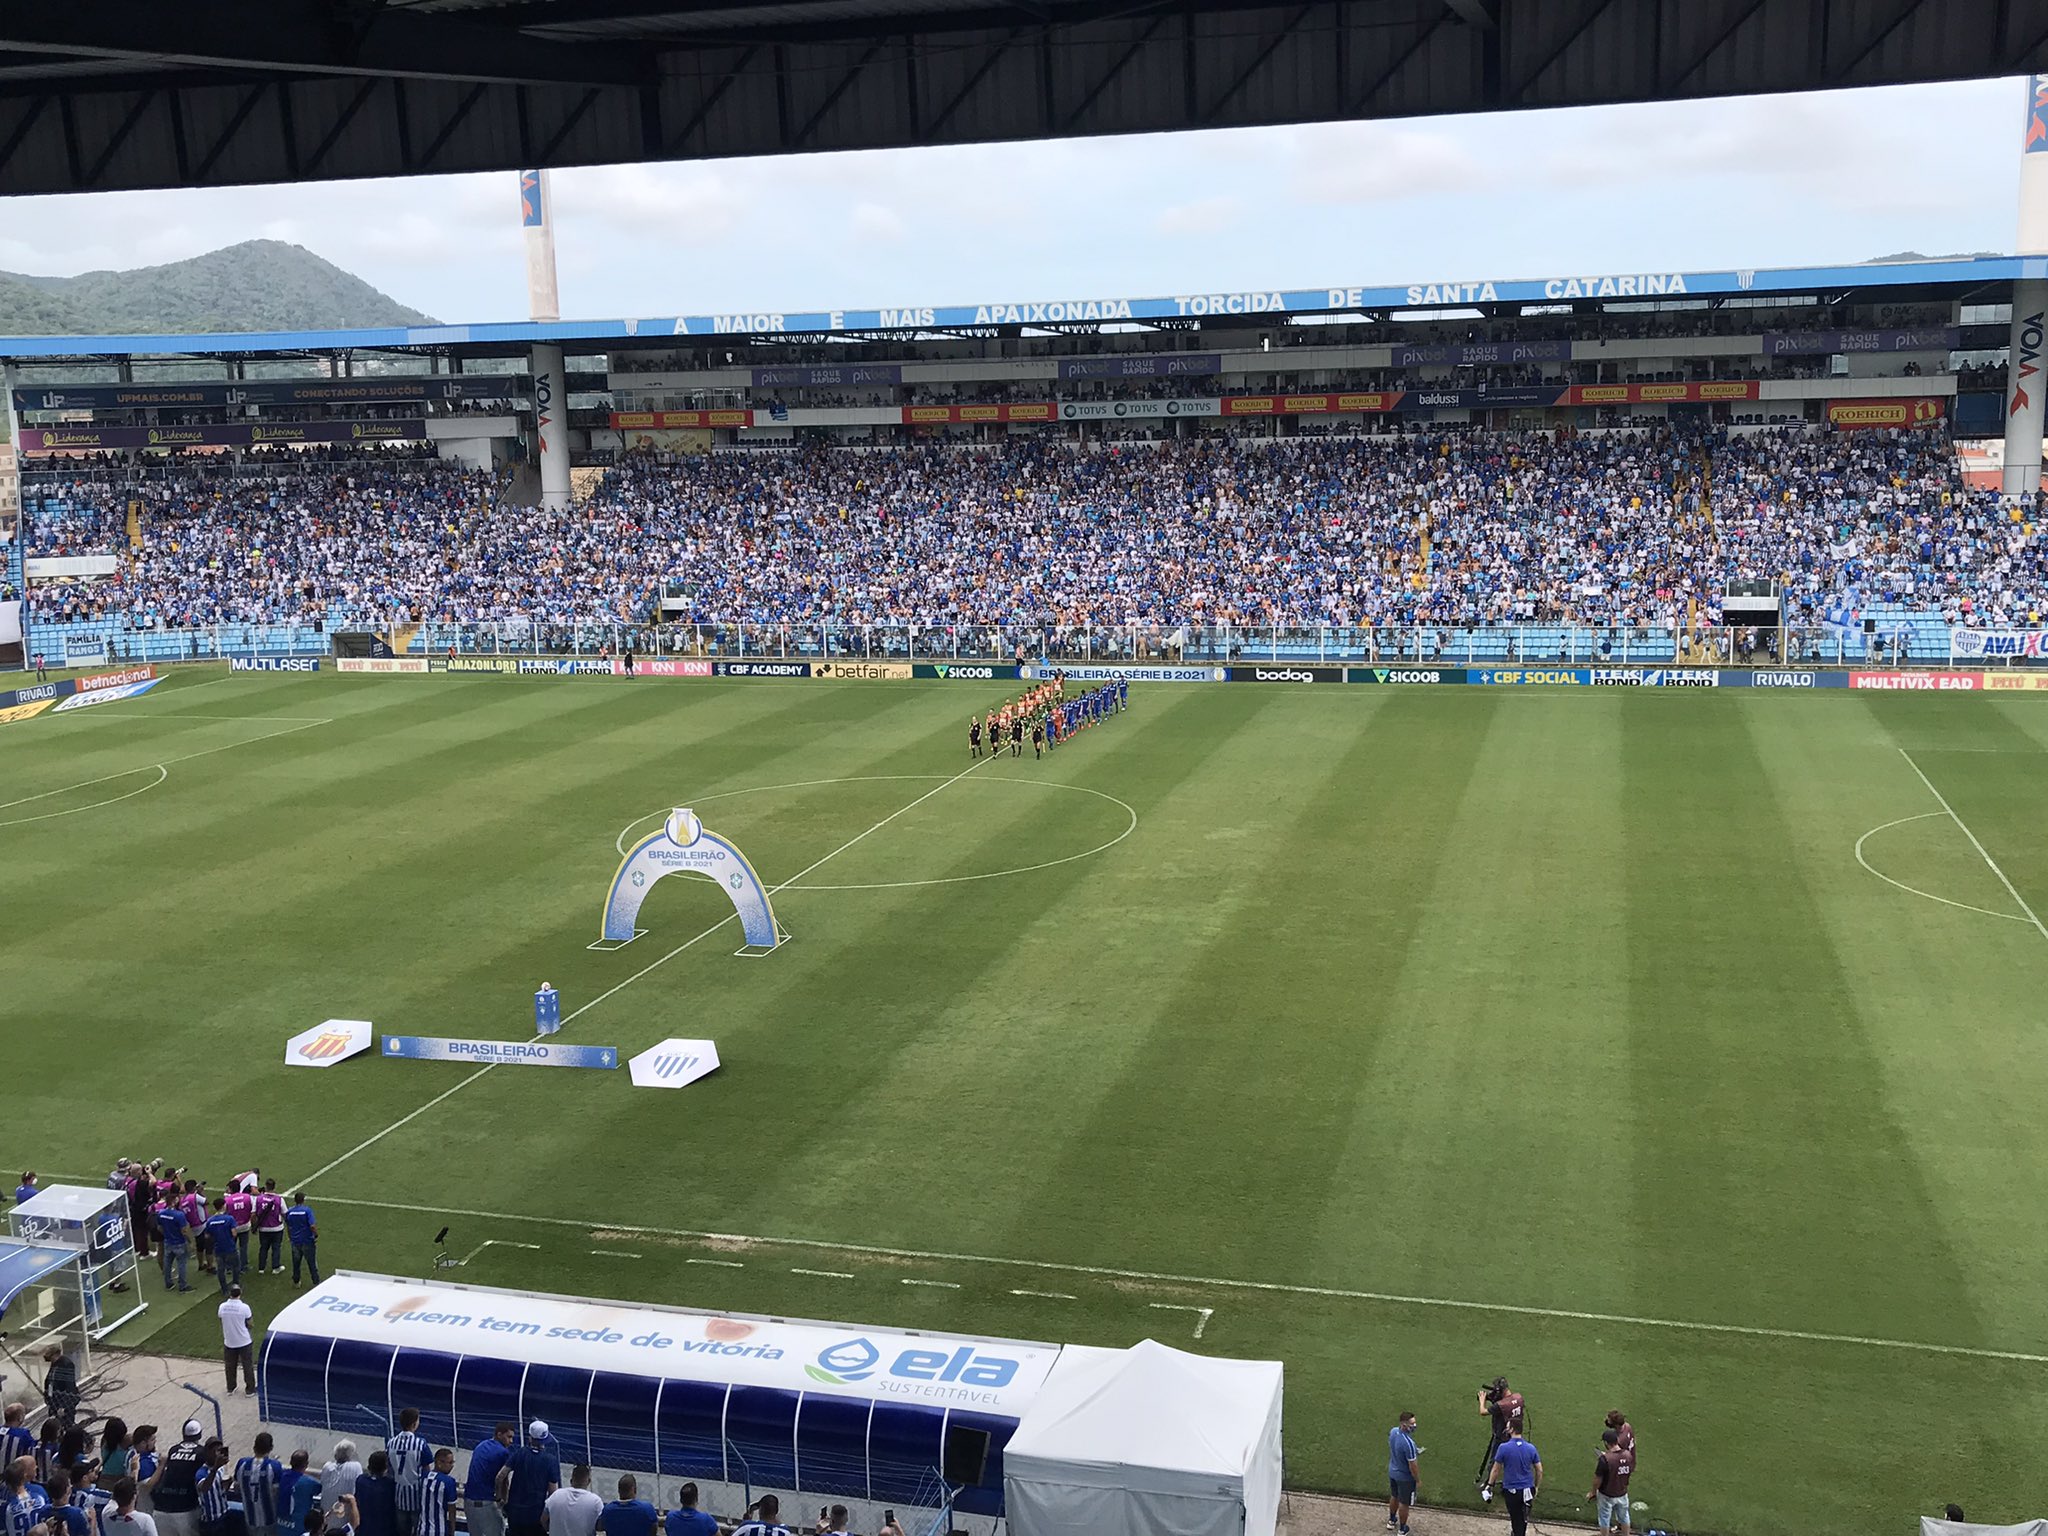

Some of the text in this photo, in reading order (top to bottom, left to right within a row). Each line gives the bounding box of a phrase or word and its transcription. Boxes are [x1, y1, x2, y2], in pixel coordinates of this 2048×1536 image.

[673, 274, 1687, 335] A MAIOR E MAIS APAIXONADA TORCIDA DE SANTA CATARINA
[1840, 334, 1879, 342] SAQUE
[294, 385, 425, 399] CONECTANDO SOLUÇÕES
[1585, 388, 1625, 396] KOERICH
[1643, 387, 1684, 395] KOERICH
[1703, 385, 1743, 394] KOERICH
[117, 391, 203, 403] UPMAIS.COM.BR
[1419, 392, 1459, 405] baldussi
[1836, 409, 1900, 420] KOERICH
[67, 634, 101, 645] FAMÍLIA
[68, 645, 100, 655] RAMOS
[232, 658, 318, 671] MULTILASER
[448, 660, 516, 671] AMAZONLORD
[523, 661, 557, 669] TEK
[577, 661, 611, 669] TEK
[652, 662, 675, 672] KNN
[684, 662, 707, 672] KNN
[730, 664, 803, 676] CBF ACADEMY
[835, 664, 909, 678] betfair.net
[948, 667, 993, 679] SICOOB
[1039, 668, 1206, 680] BRSILEIRÃO SÉRIE B 2021
[1256, 668, 1314, 683] bodog
[1389, 671, 1440, 683] SICOOB
[1594, 670, 1640, 678] TEK
[1666, 670, 1712, 679] TEK
[82, 667, 151, 690] betnacional
[1494, 672, 1580, 685] CBF SOCIAL
[1594, 678, 1641, 686] BOND
[1666, 678, 1713, 687] BOND
[1757, 673, 1812, 686] RIVALO
[1857, 677, 1974, 689] MULTIVIX EAD
[18, 686, 54, 702] RIVALO
[648, 850, 726, 861] BRASILEIRÃO
[449, 1042, 549, 1059] BRASILEIRÃO
[309, 1295, 785, 1361] Para quem tem sede de vitória
[888, 1347, 1020, 1388] ela
